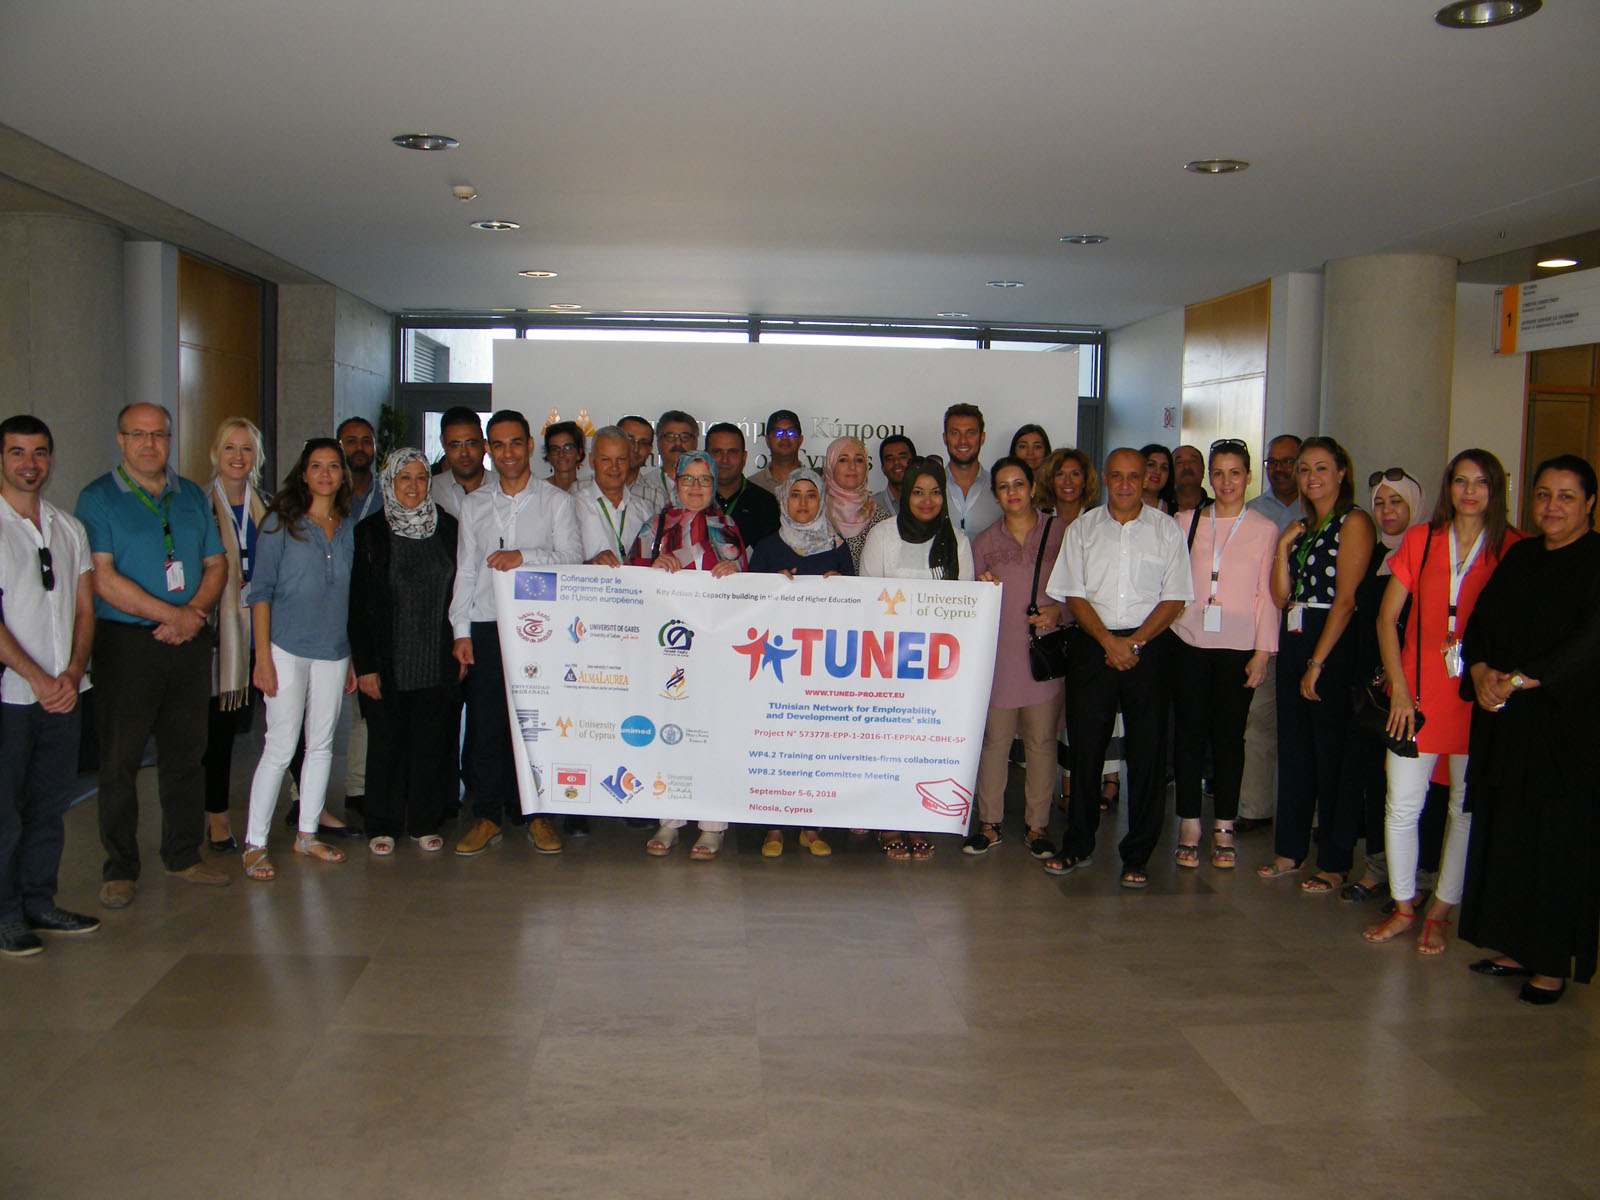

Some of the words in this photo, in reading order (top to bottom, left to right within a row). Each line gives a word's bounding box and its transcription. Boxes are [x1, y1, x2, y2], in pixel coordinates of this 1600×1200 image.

[1505, 312, 1512, 327] 1
[561, 574, 599, 584] Cofinancé
[600, 577, 613, 586] par
[614, 577, 622, 585] le
[560, 585, 603, 594] programme
[605, 585, 643, 595] Erasmus+
[560, 592, 570, 600] de
[571, 592, 598, 601] l'Union
[599, 594, 644, 605] européenne
[702, 591, 731, 600] Capacity
[731, 592, 759, 601] building
[759, 593, 767, 601] in
[805, 595, 827, 604] Higher
[828, 596, 862, 604] Education
[916, 592, 978, 608] University
[916, 606, 930, 617] of
[934, 607, 977, 621] Cyprus
[589, 623, 617, 631] UNIVERSITÉ
[792, 628, 961, 681] TUNED
[804, 689, 905, 699] WWW.TUNED-PROJECT.EU
[768, 702, 810, 711] TUnisian
[812, 703, 854, 712] Network
[856, 704, 870, 713] for
[872, 705, 937, 716] Employability
[579, 719, 616, 731] University
[766, 712, 784, 720] and
[786, 712, 849, 722] Development
[852, 714, 862, 722] of
[917, 716, 942, 725] skills
[578, 728, 587, 738] of
[589, 729, 616, 741] Cyprus
[621, 727, 652, 736] unimed
[754, 728, 785, 738] Project
[799, 730, 967, 744] 573778-EPP-1-2016-IT-EPPKA2-CBHE-SP
[748, 750, 777, 759] WP4.2
[779, 751, 814, 761] Training
[828, 752, 902, 764] universities-firms
[903, 756, 960, 765] collaboration
[748, 767, 776, 776] WP8.2
[777, 768, 814, 778] Steering
[815, 770, 862, 779] Committee
[864, 771, 901, 781] Meeting
[749, 787, 796, 798] September
[798, 789, 814, 798] 5-6,
[815, 790, 837, 798] 2018
[749, 803, 782, 813] Nicosia,
[784, 805, 814, 815] Cyprus
